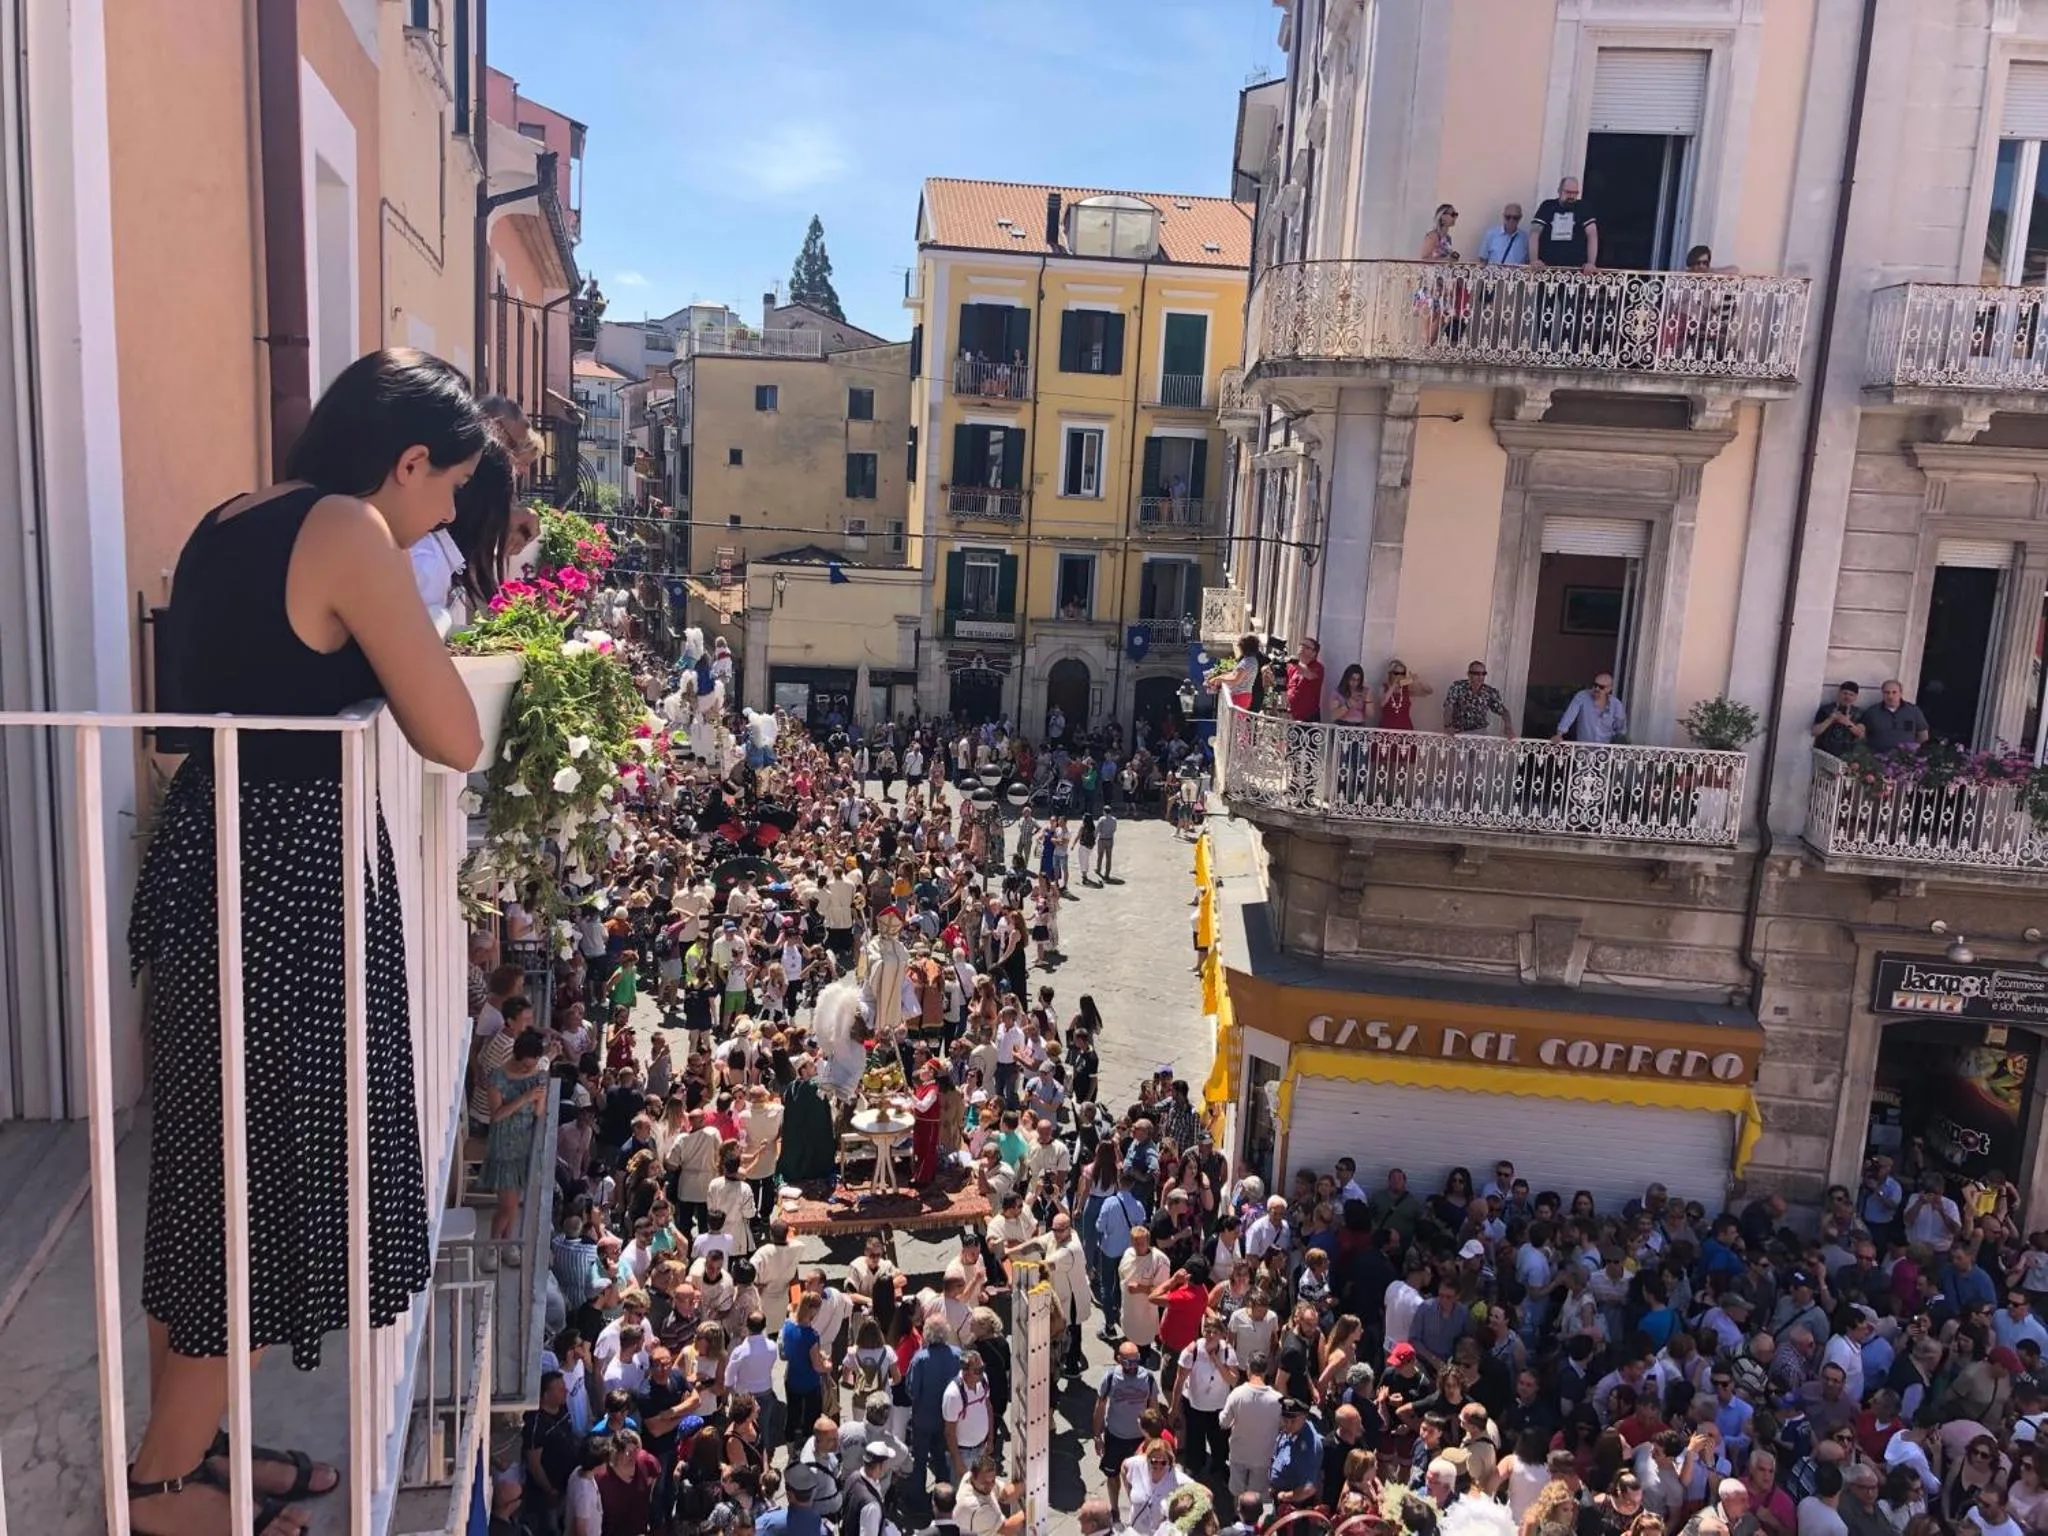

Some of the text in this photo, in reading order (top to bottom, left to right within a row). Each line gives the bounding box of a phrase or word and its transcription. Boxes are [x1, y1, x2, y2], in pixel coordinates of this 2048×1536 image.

[1901, 965, 1990, 998] Jackpot
[1994, 977, 2045, 990] Scommesse
[2016, 1002, 2048, 1014] machin
[1308, 1015, 1744, 1080] CASA DEL CORREDO
